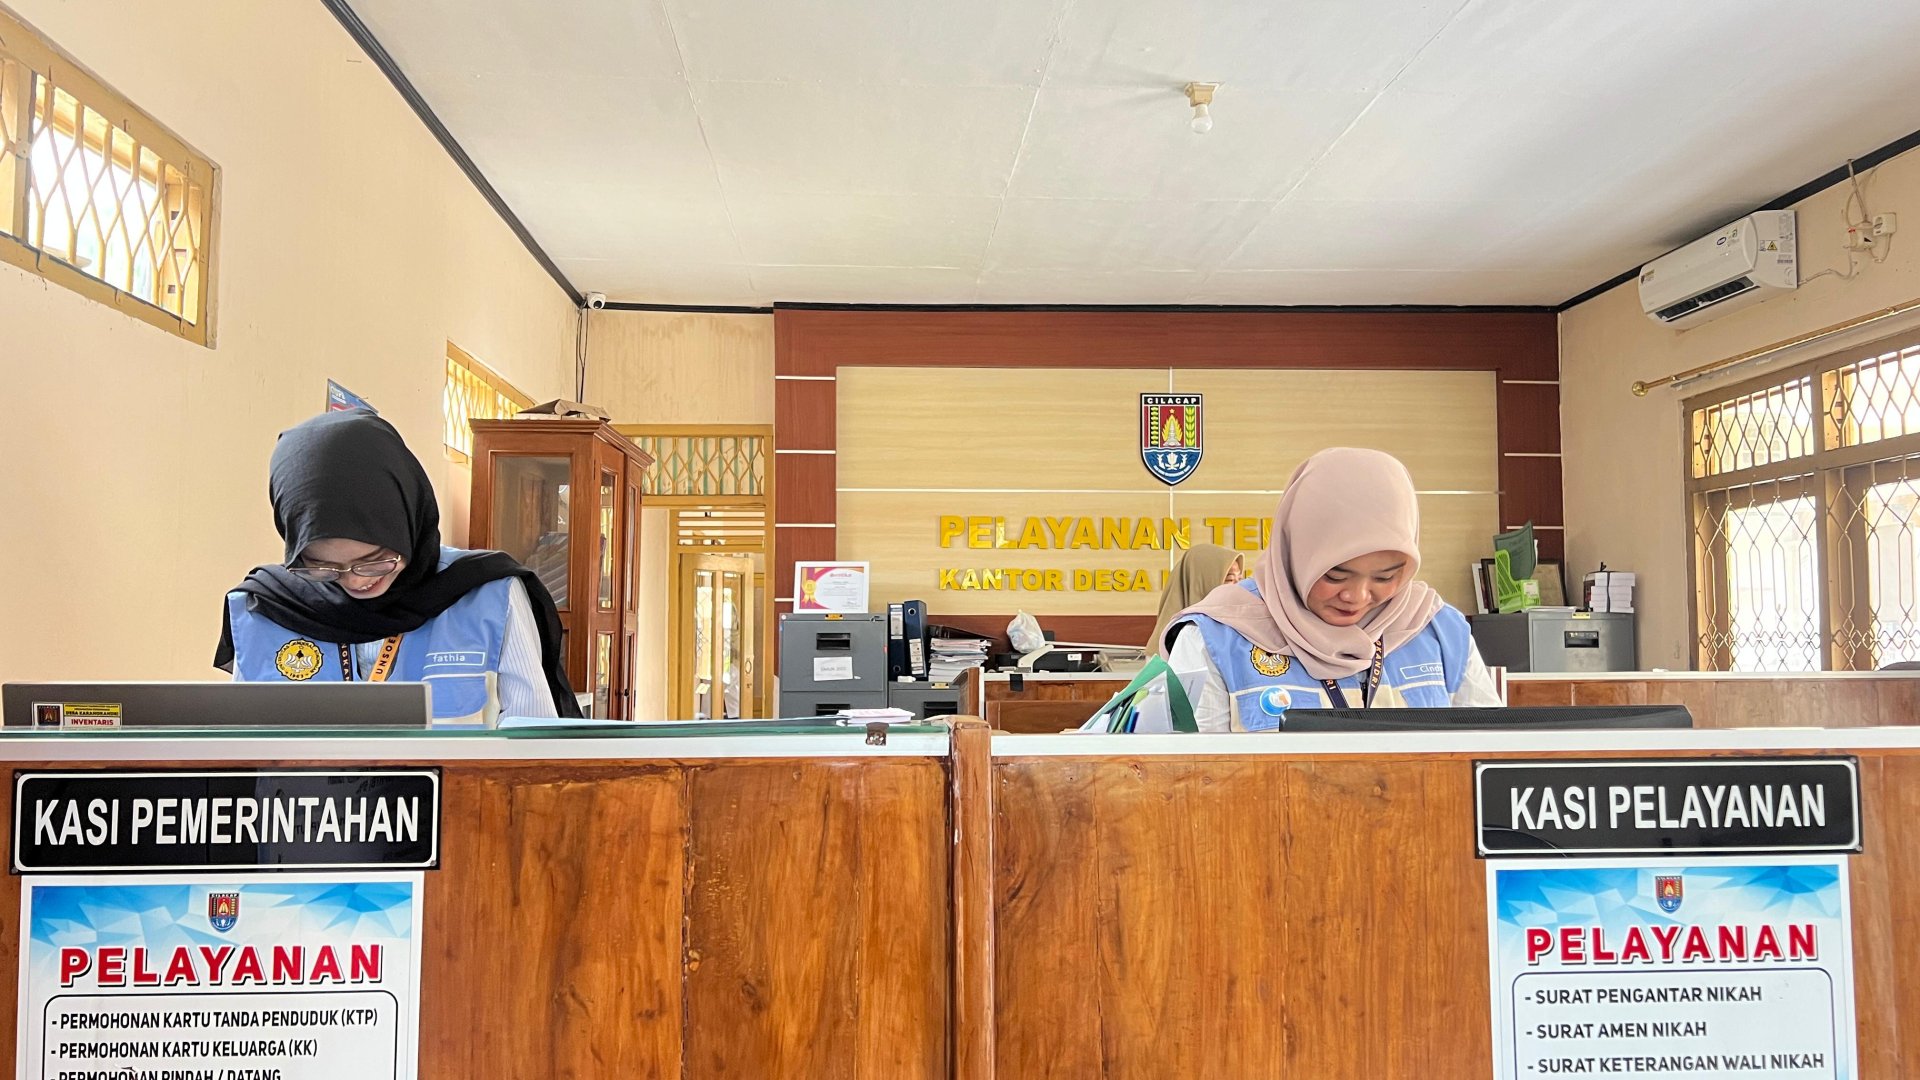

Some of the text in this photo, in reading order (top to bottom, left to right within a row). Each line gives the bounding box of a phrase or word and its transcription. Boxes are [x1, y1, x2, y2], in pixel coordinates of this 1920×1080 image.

[940, 516, 1191, 550] PELAYANAN
[939, 568, 1063, 591] KANTOR
[1074, 569, 1153, 592] DESA
[433, 653, 466, 663] fathia
[1511, 785, 1825, 829] KASI PELAYANAN
[35, 797, 418, 845] KASI PEMERINTAHAN
[1526, 924, 1819, 965] PELAYANAN
[60, 944, 384, 987] PELAYANAN
[1536, 989, 1592, 1004] SURAT
[1597, 988, 1702, 1003] PENGANTAR
[1707, 987, 1761, 1002] NIKAH
[61, 1012, 159, 1029] PERMOHONAN
[164, 1012, 210, 1028] KARTU
[213, 1011, 259, 1027] TANDA
[262, 1010, 338, 1026] PENDUDUK
[341, 1009, 377, 1026] (KTP)
[1537, 1024, 1593, 1039] SURAT
[1598, 1023, 1647, 1038] AMEN
[1653, 1022, 1706, 1037] NIKAH
[60, 1042, 158, 1058] PERMOHONAN
[163, 1041, 209, 1057] KARTU
[213, 1040, 286, 1057] KELUARGA
[289, 1039, 317, 1057] (KK)
[1539, 1058, 1595, 1073] SURAT
[1600, 1056, 1718, 1072] KETERANGAN
[1722, 1055, 1766, 1070] WALI
[1771, 1054, 1824, 1069] NIKAH
